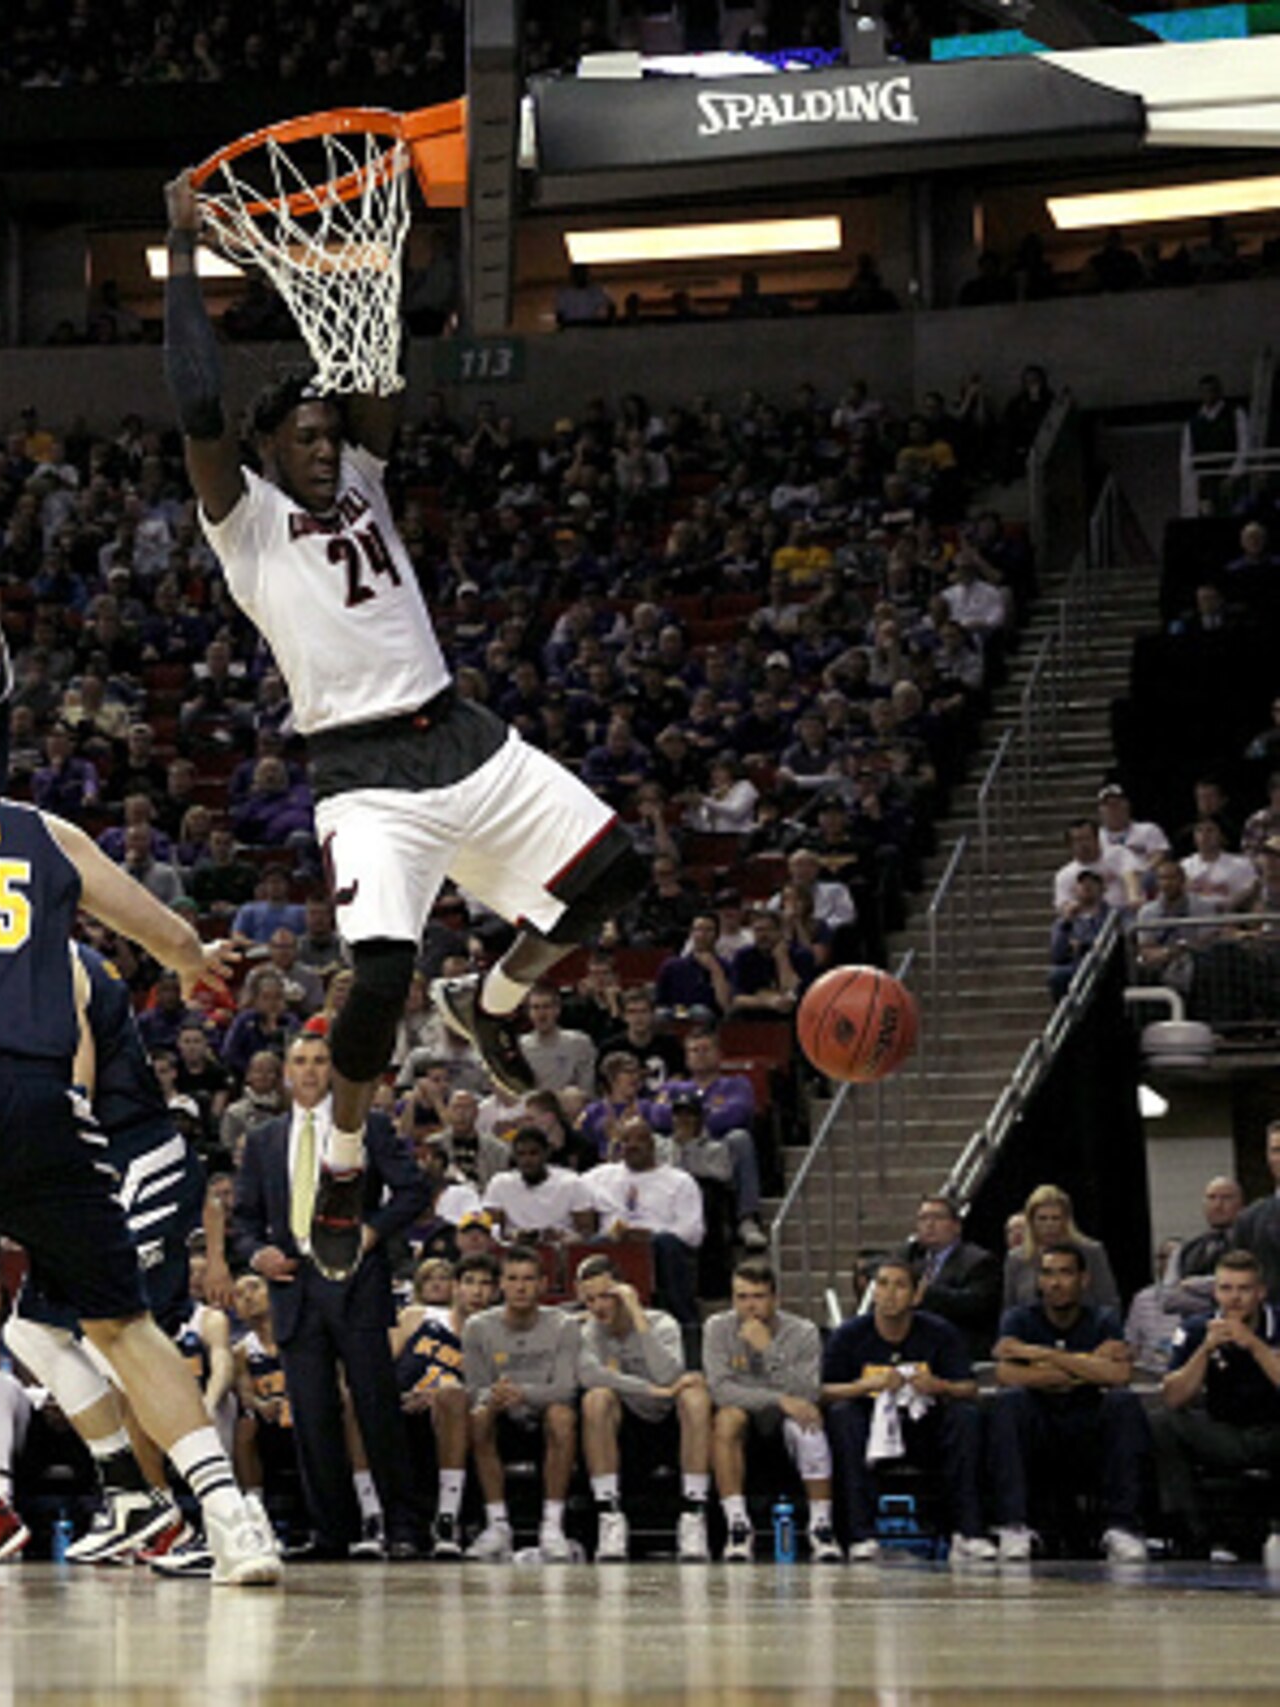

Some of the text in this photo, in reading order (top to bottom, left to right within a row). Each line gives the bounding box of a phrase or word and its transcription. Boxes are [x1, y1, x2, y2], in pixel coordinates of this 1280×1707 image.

[697, 77, 912, 135] SPALDING
[461, 348, 513, 377] 113
[327, 521, 402, 608] 24
